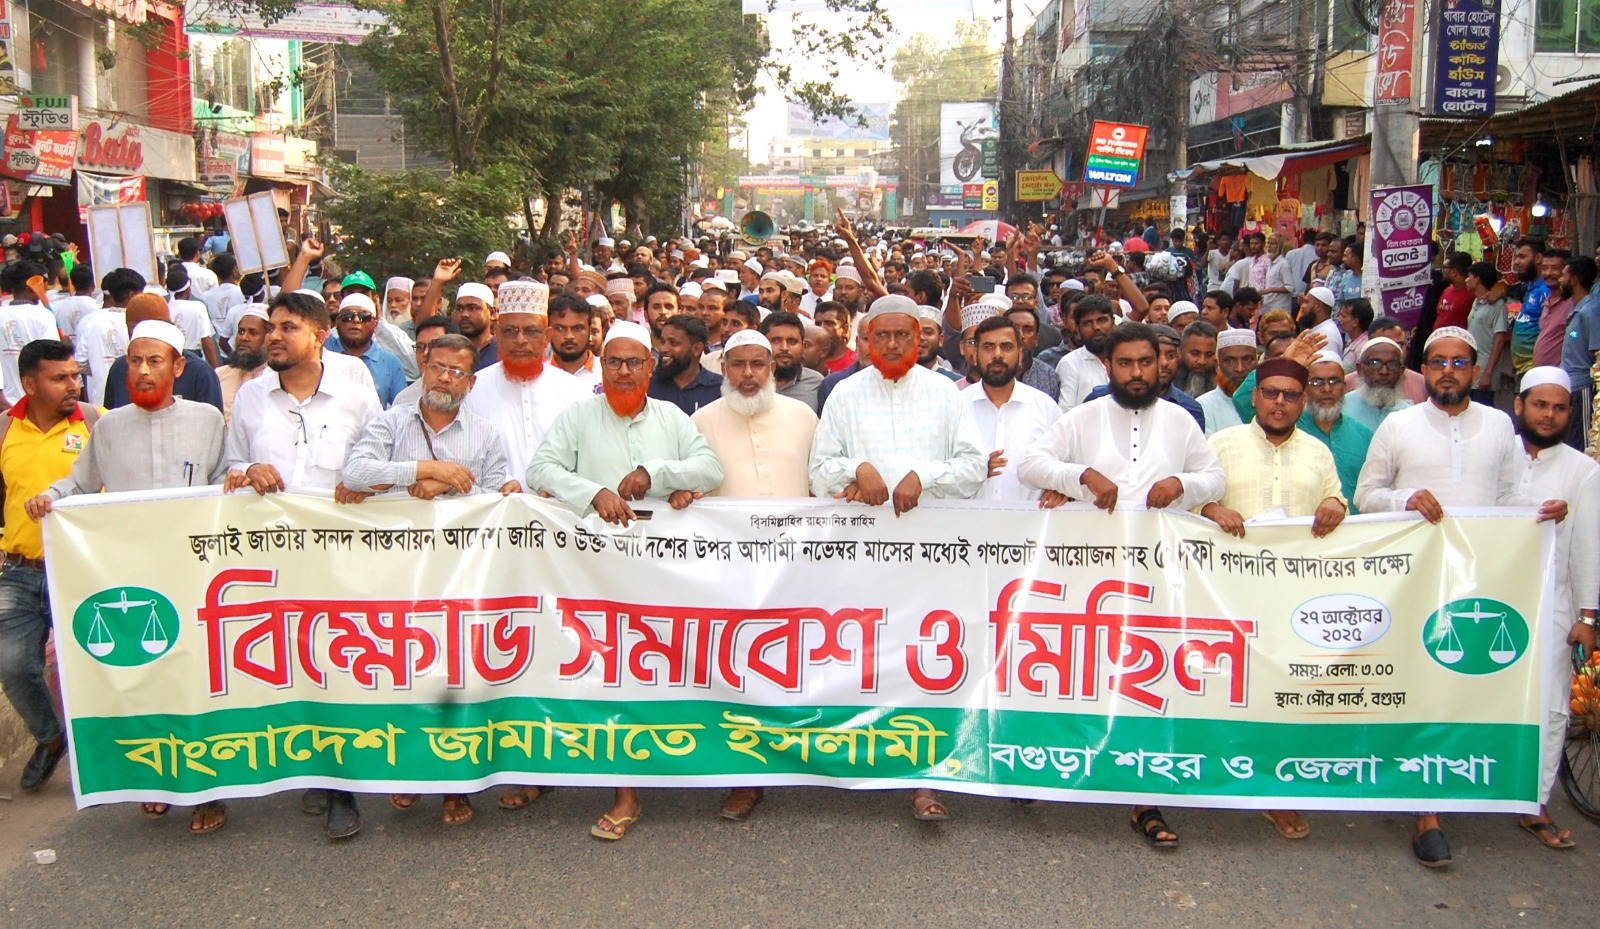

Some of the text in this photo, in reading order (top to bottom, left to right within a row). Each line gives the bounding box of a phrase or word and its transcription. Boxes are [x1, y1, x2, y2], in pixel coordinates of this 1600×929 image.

[1444, 9, 1496, 24] খাবার হোটেল
[1447, 24, 1492, 38] খোলা আছে
[1449, 53, 1486, 65] কাচ্চি
[1448, 66, 1486, 80] হাউস
[1445, 87, 1486, 99] বাংলা
[36, 97, 68, 108] FUJI
[1442, 100, 1487, 112] হোটেল
[22, 109, 69, 128] স্টুডিও
[80, 122, 143, 170] Bata
[1108, 139, 1138, 149] PARKING
[1088, 170, 1132, 183] WALTON
[1390, 293, 1424, 314] রকেট
[805, 514, 847, 527] রাহমানির
[850, 514, 876, 528] রাহিম
[188, 524, 243, 562] জুলাই
[246, 520, 307, 552] জাতীয়
[311, 529, 354, 551] সনদ
[359, 527, 436, 552] বাস্তবায়ন
[507, 519, 546, 549] জারি
[553, 530, 567, 549] ও
[575, 525, 606, 553] উক্ত
[612, 532, 688, 560] আদেশের
[693, 535, 731, 562] উপর
[737, 531, 796, 562] আগামী
[801, 539, 858, 562] নভেম্বর
[863, 538, 914, 563] মাসের
[920, 536, 971, 566] মধ্যেই
[977, 538, 1037, 566] গণভোট
[1044, 543, 1117, 567] আয়োজন
[1120, 546, 1149, 571] সহ
[1179, 537, 1215, 572] দফা
[1221, 549, 1277, 577] গণদাবি
[1282, 554, 1356, 578] আদায়ের
[1362, 552, 1413, 577] লক্ষ্যে
[1300, 606, 1383, 626] ২৭ অক্টোবর
[197, 568, 1258, 715] বিক্ষোভ সমাবেশ ও মিছিল
[1322, 628, 1362, 642] ২০২৫
[1289, 663, 1394, 679] সময়: বেলা: ৩.০০
[1274, 686, 1407, 708] স্থান: পৌর পার্ক, বগুড়া
[114, 710, 1498, 786] বাংলাদেশ জামায়াতে ইসলামী, বগুড়া শহর ও জেলা শাখা
